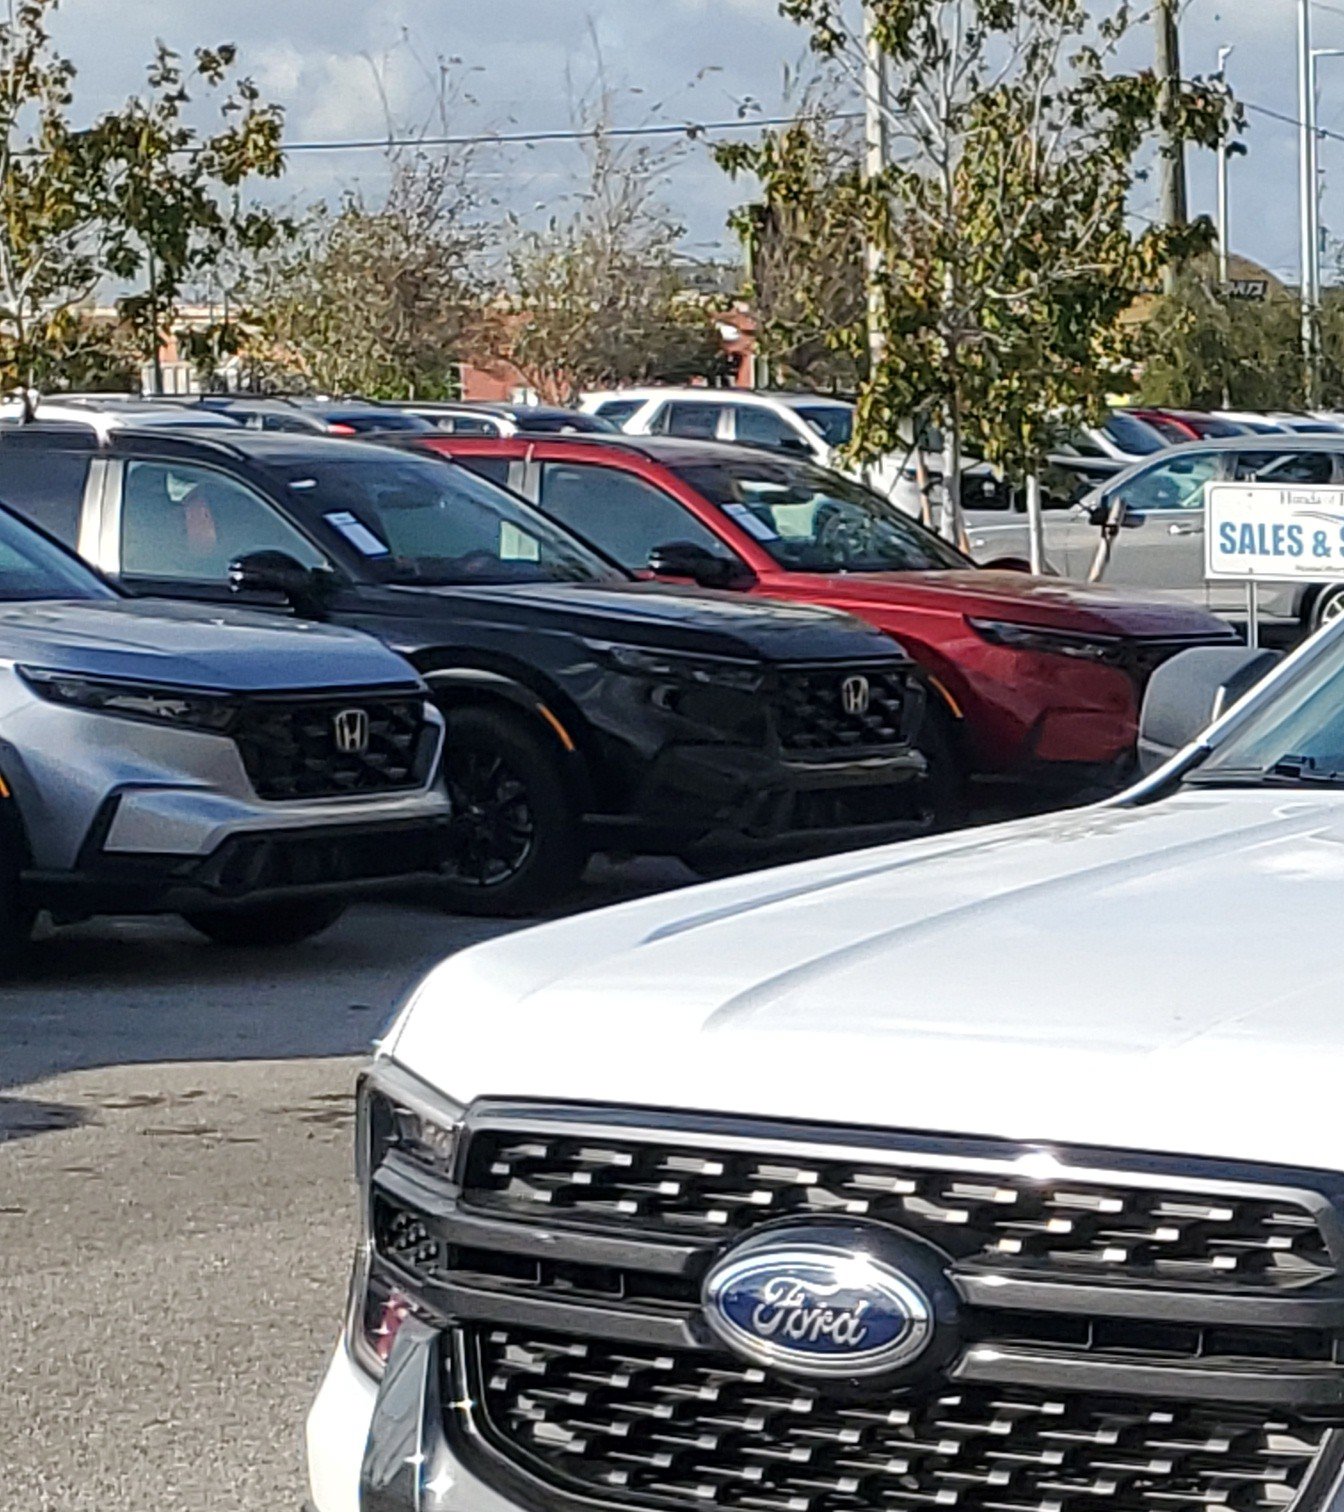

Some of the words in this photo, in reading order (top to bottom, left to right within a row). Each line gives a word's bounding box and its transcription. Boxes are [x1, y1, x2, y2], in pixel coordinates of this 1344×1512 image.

[1219, 521, 1304, 557] SALES
[1312, 530, 1332, 558] &
[752, 1276, 870, 1346] Ford
